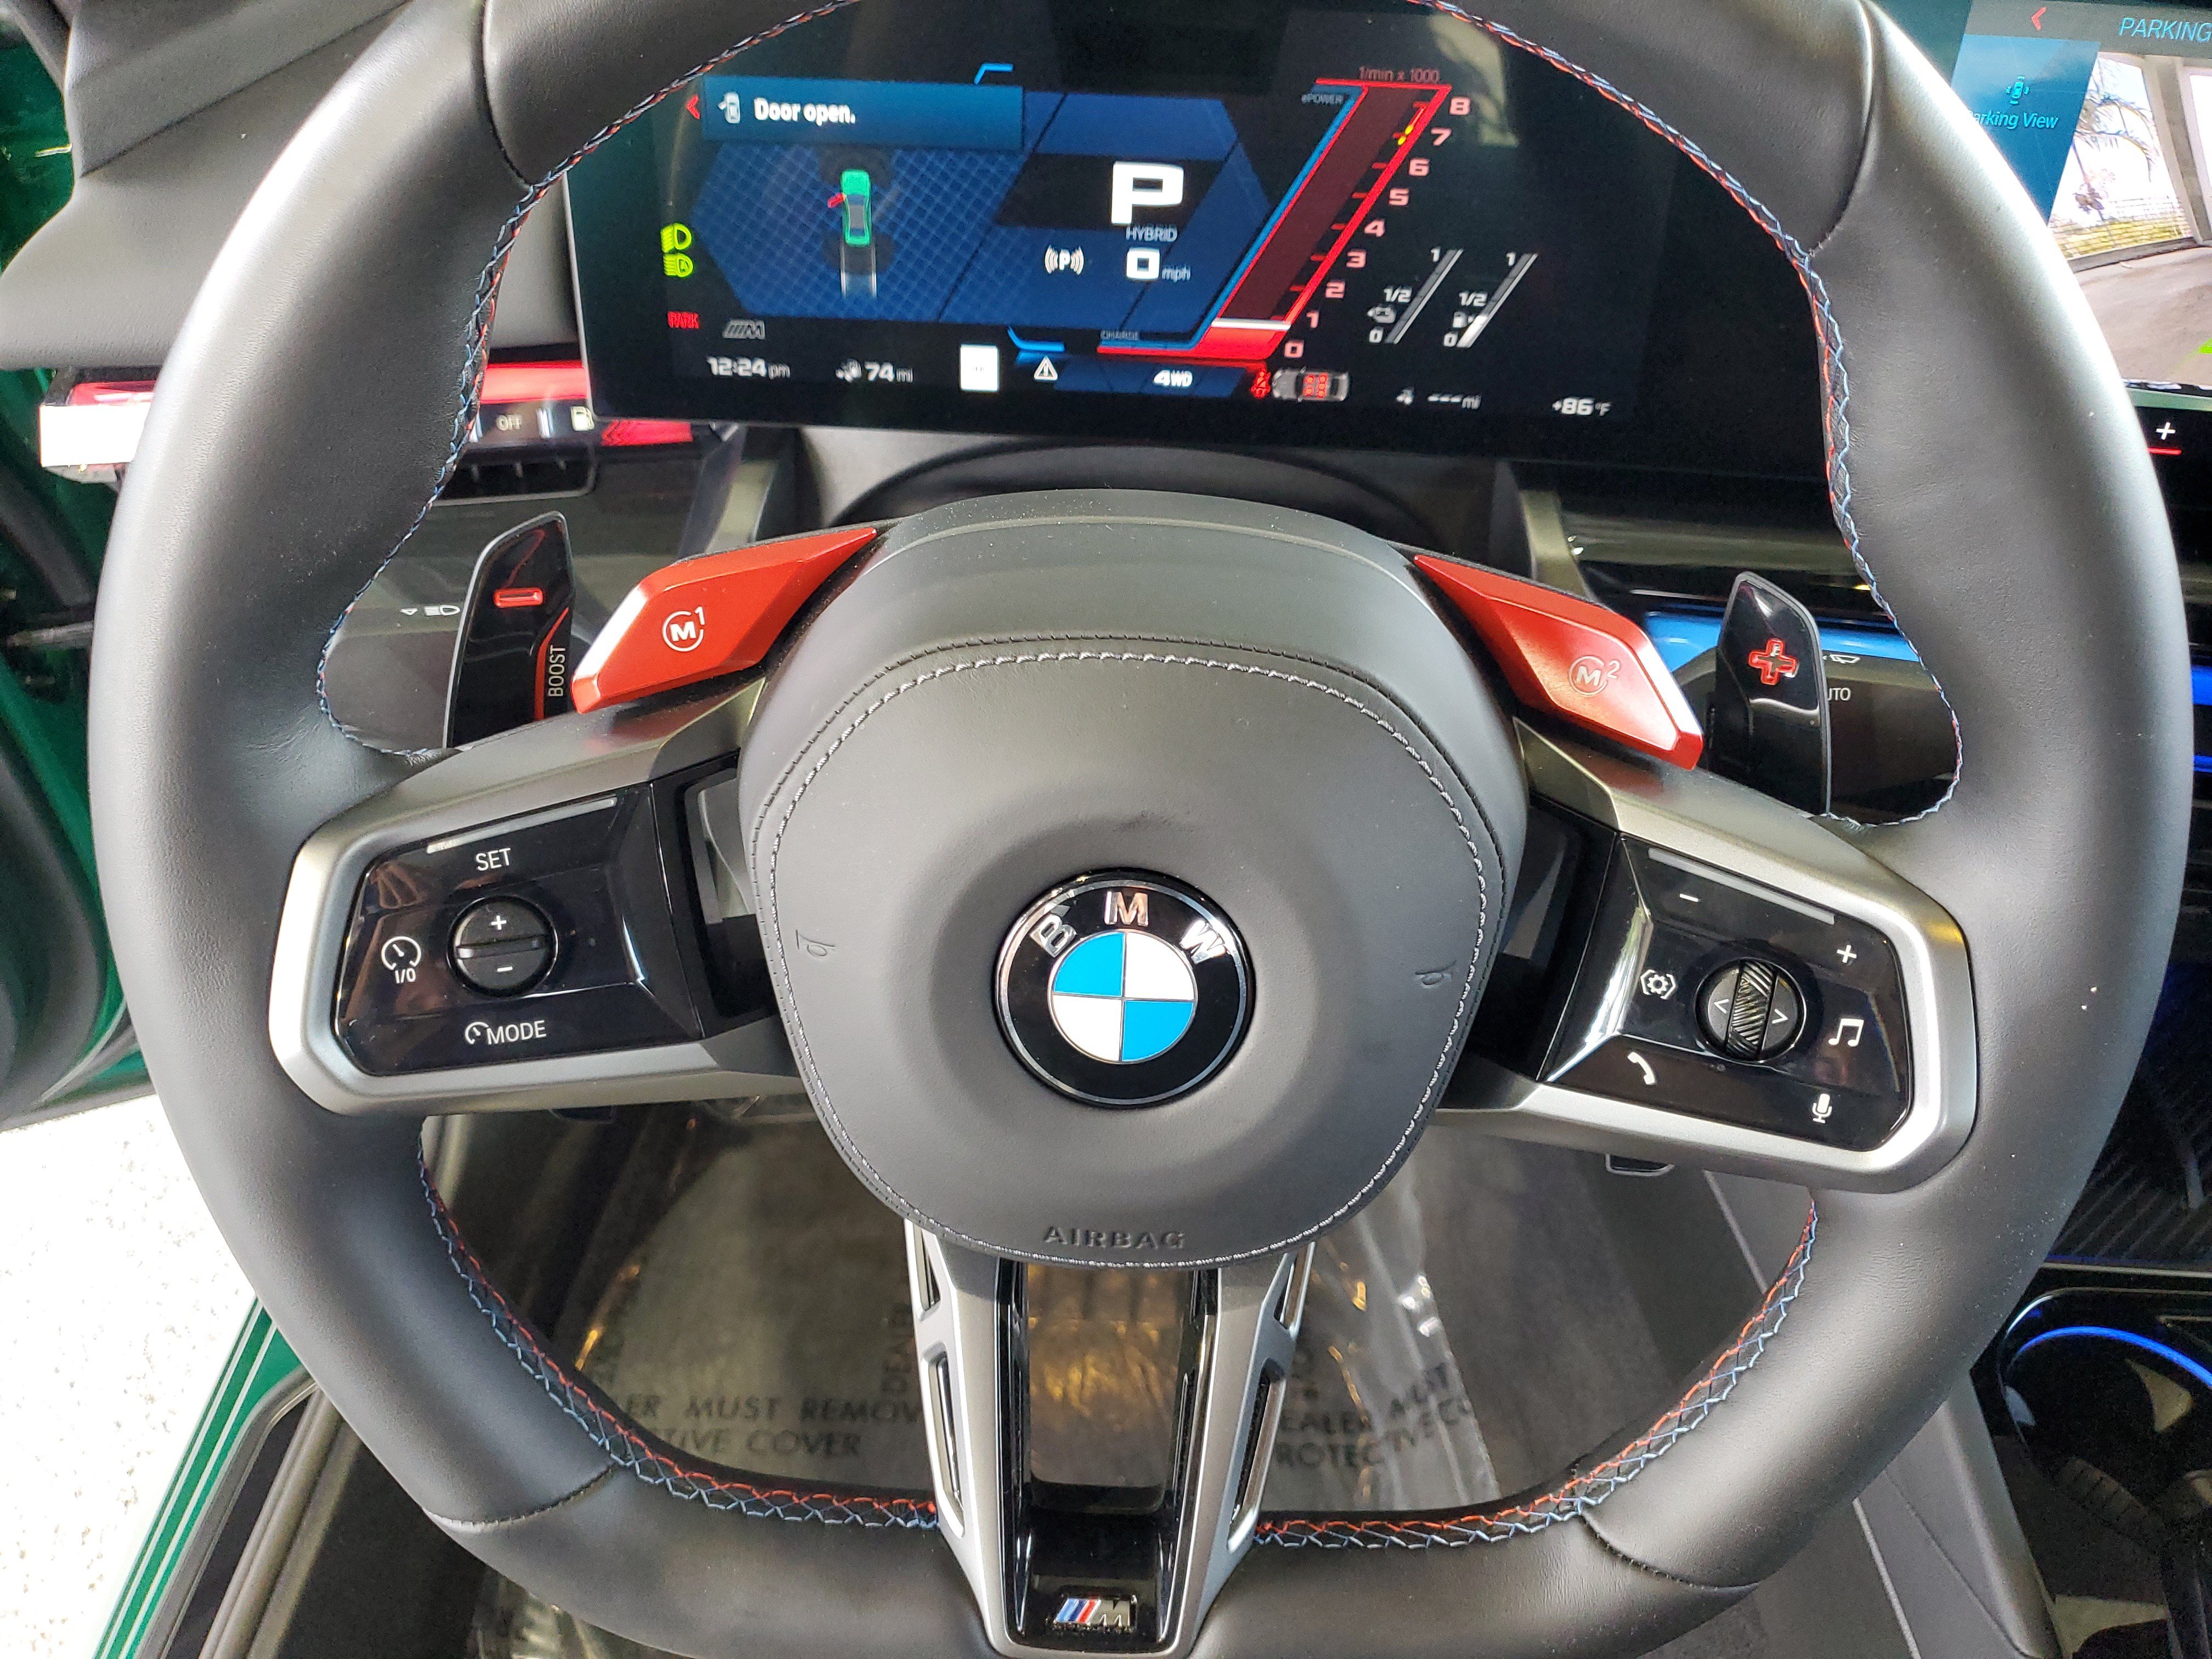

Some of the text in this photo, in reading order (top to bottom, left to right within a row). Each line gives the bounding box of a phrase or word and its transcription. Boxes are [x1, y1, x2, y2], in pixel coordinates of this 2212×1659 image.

[2119, 17, 2212, 42] PARKING
[1410, 68, 1440, 83] 1000
[754, 97, 856, 127] Door open.
[1449, 97, 1471, 116] 8
[1969, 110, 2058, 129] arking View
[1431, 128, 1452, 146] 7
[1409, 158, 1430, 176] 6
[1111, 161, 1184, 226] P
[1389, 188, 1409, 206] 5
[1125, 224, 1177, 242] HYBRID
[1364, 219, 1385, 237] 4
[1346, 249, 1366, 268] 3
[1430, 246, 1441, 262] 1
[1506, 251, 1516, 266] 1
[1126, 247, 1191, 283] 0 mph
[1325, 280, 1346, 298] 2
[1383, 284, 1412, 302] 1/2
[1458, 290, 1488, 307] 1/2
[668, 310, 699, 329] PARK
[1306, 311, 1319, 328] 1
[1369, 326, 1384, 343] 0
[1443, 331, 1459, 347] 0
[1284, 340, 1305, 358] 0
[706, 356, 791, 380] 12:24 pm
[864, 361, 913, 383] 74 mi
[1153, 369, 1193, 387] 4WD
[496, 414, 522, 432] OFF
[548, 645, 566, 697] BOOST
[1827, 687, 1851, 701] UTO
[476, 848, 511, 872] SET
[1030, 891, 1228, 964] BMW
[487, 1020, 547, 1045] MODE
[1043, 1225, 1186, 1249] AIRBAG
[625, 1393, 924, 1425] ER MUST REMOV
[663, 1426, 863, 1458] TIVE COVER
